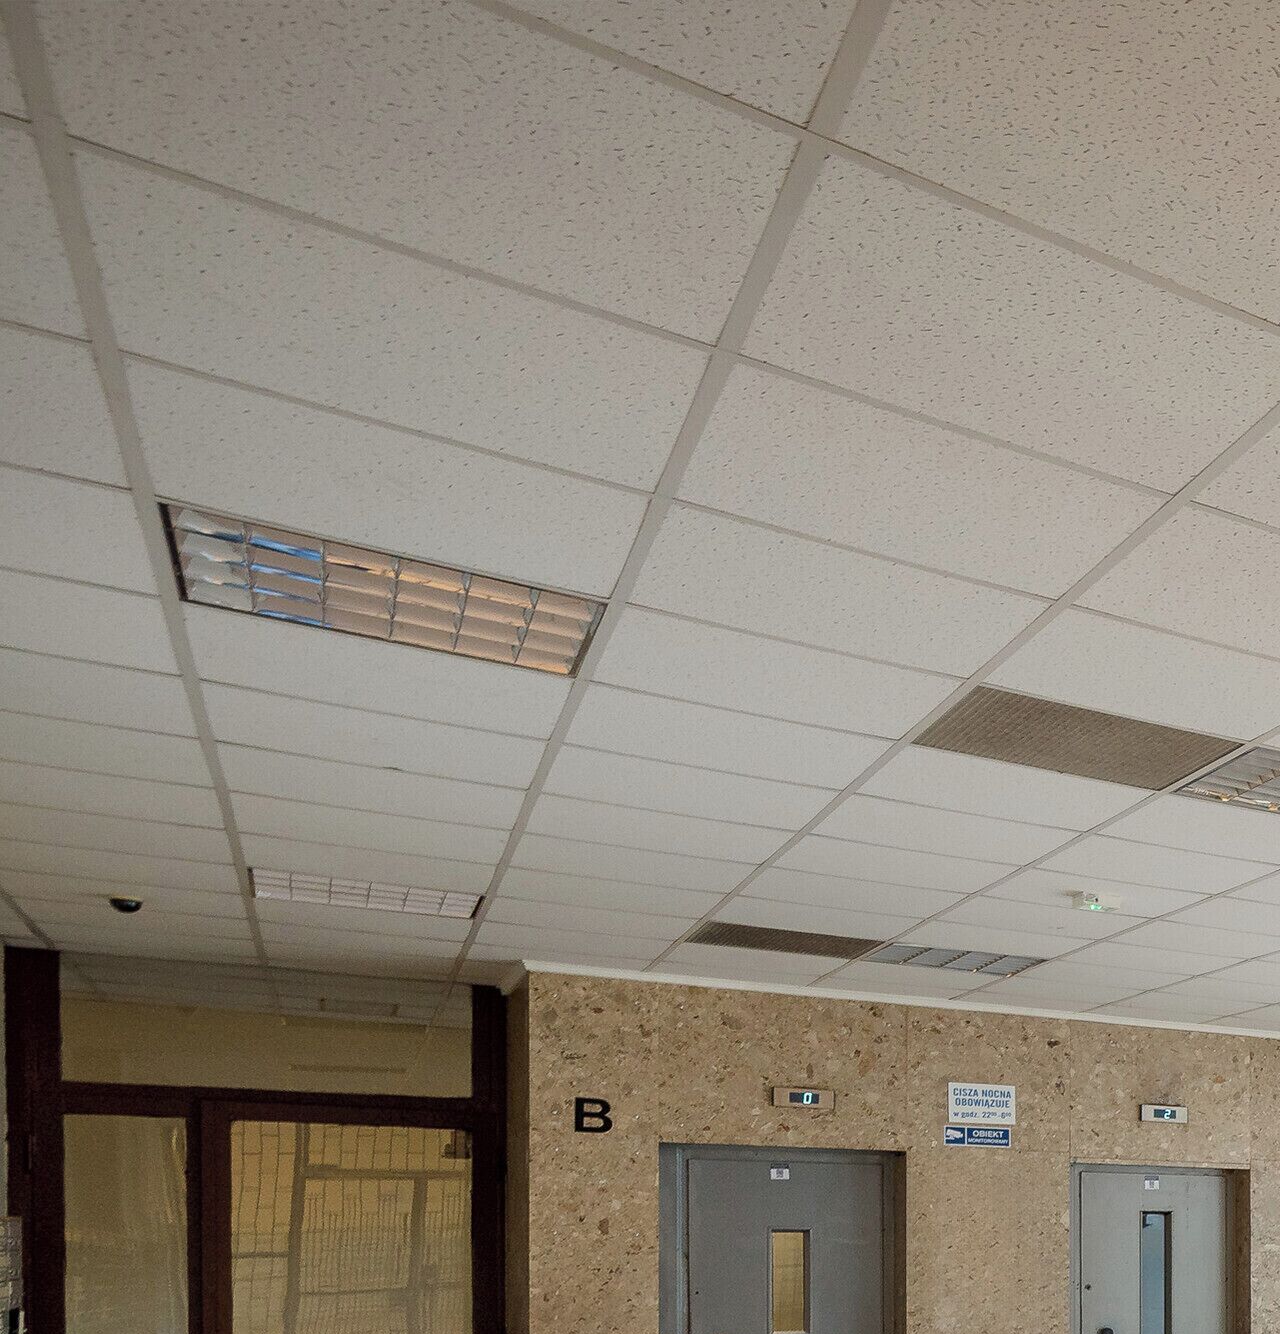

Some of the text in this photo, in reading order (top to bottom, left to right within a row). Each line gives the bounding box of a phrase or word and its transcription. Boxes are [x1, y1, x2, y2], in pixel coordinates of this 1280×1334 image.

[953, 1087, 1011, 1098] CISZA NOCNA
[803, 1092, 812, 1105] 0
[955, 1097, 1010, 1108] OBOWIĄZUJE
[575, 1097, 613, 1133] B
[1164, 1109, 1171, 1120] 2
[972, 1130, 1004, 1138] OBIEKT
